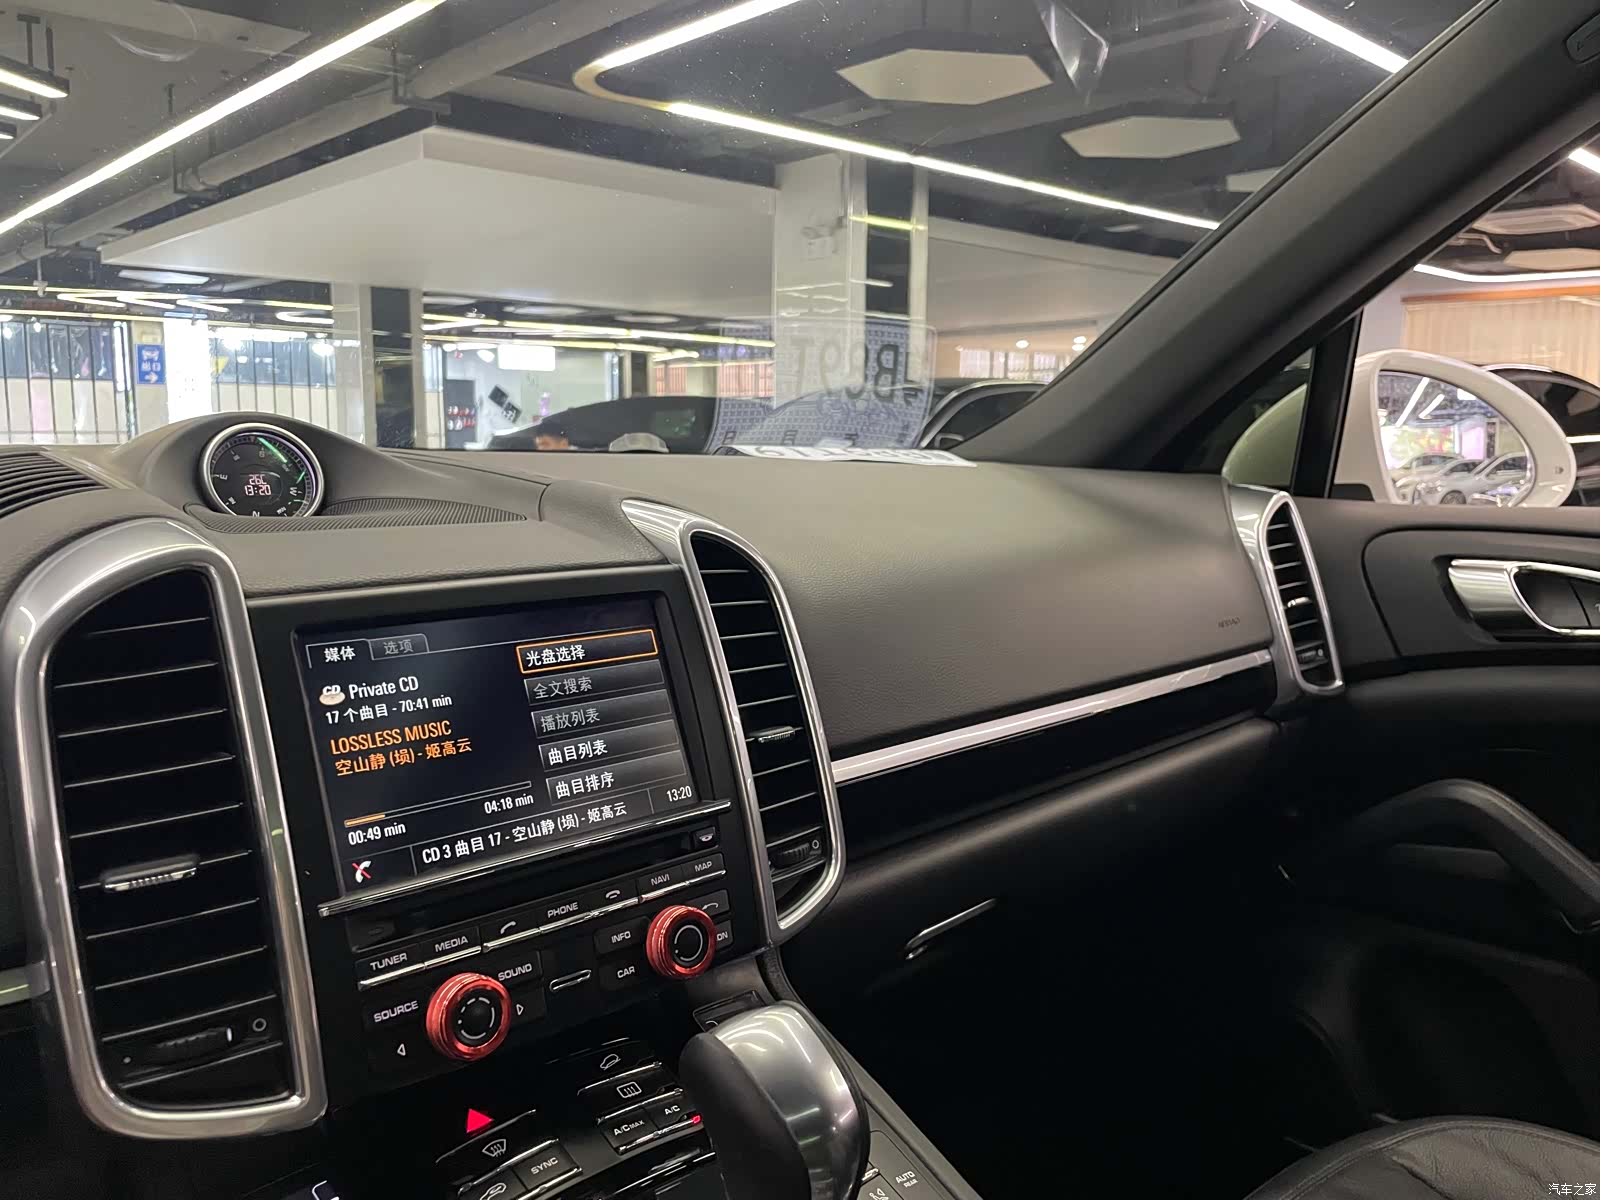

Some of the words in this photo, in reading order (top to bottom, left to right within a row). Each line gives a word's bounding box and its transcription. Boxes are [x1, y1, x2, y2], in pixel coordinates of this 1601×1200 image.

[244, 485, 272, 496] 13:20
[323, 645, 356, 663] 媒体
[383, 639, 414, 656] 选项
[526, 644, 586, 667] 光盘选择
[348, 681, 397, 700] Private
[399, 676, 419, 692] CD
[533, 675, 593, 700] 全文搜索
[325, 710, 340, 725] 17
[343, 704, 389, 723] 个曲目
[399, 697, 429, 713] 70:41
[432, 694, 453, 708] min
[540, 708, 600, 733] 播放列表
[330, 728, 402, 755] LOSSLESS
[404, 720, 452, 743] MUSIC
[335, 753, 386, 776] 空山静
[425, 737, 472, 760] 姬高云
[548, 739, 608, 766] 曲目列表
[555, 771, 615, 799] 曲目排序
[666, 785, 693, 802] 13:20
[484, 797, 513, 814] 04:18
[514, 793, 534, 807] min
[348, 826, 382, 846] 00:49
[384, 822, 406, 838] min
[422, 847, 441, 864] CD
[443, 844, 452, 859] 3
[455, 836, 484, 858] 曲目
[488, 832, 501, 847] 17
[512, 818, 554, 842] 空山静
[694, 861, 712, 872] MAP
[650, 873, 670, 886] NAVI
[547, 902, 579, 918] PHONE
[434, 935, 468, 952] MEDIA
[611, 931, 631, 944] INFO
[370, 952, 408, 971] TUNER
[497, 963, 533, 981] SOUND
[617, 965, 635, 979] CAR
[373, 1000, 419, 1023] SOURCE
[664, 1105, 681, 1115] A/C
[530, 1157, 559, 1175] SYNC
[895, 1170, 916, 1184] AUTO
